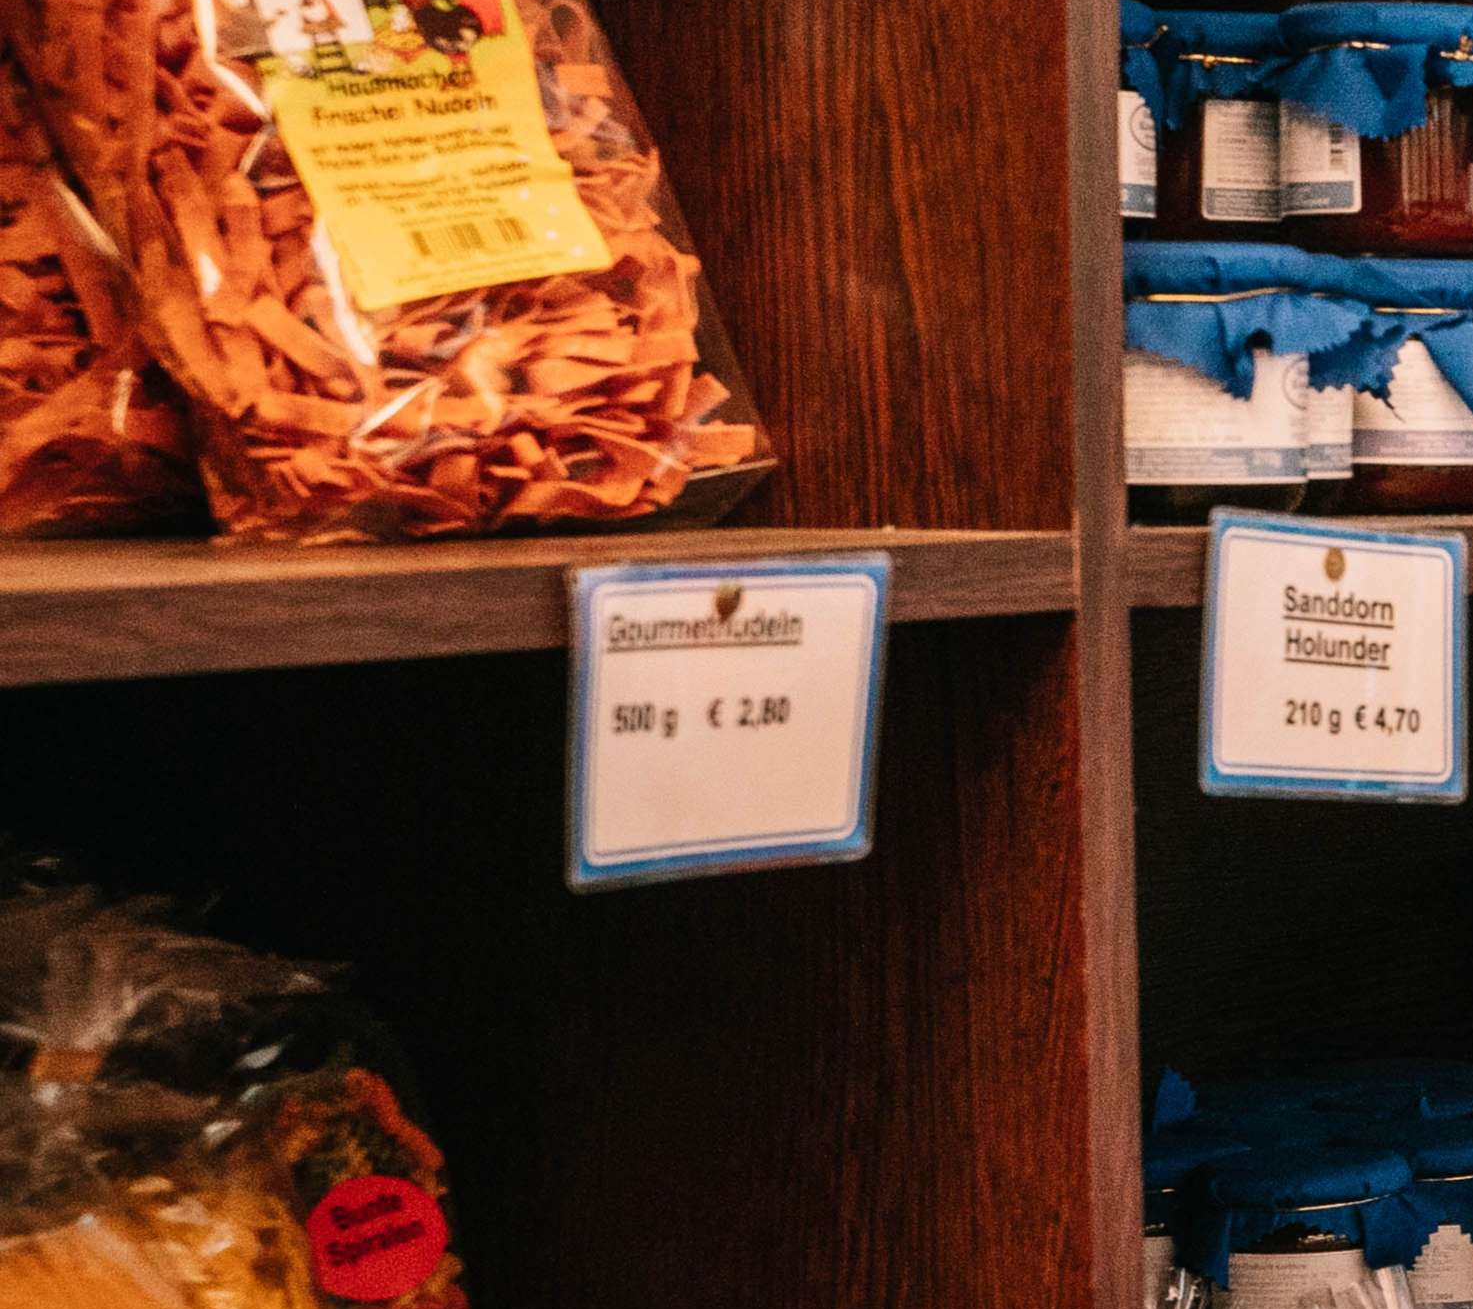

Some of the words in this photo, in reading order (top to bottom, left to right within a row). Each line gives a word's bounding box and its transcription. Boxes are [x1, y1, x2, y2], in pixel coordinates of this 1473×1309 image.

[1283, 584, 1396, 625] Sanddorn
[1285, 628, 1391, 666] Holunder
[613, 703, 655, 735] 500
[662, 709, 680, 738] g
[706, 698, 722, 731] €
[736, 695, 792, 733] 2,80
[1284, 699, 1323, 729] 210
[1327, 708, 1343, 735] g
[1354, 707, 1368, 731] €
[1373, 709, 1421, 738] 4,70
